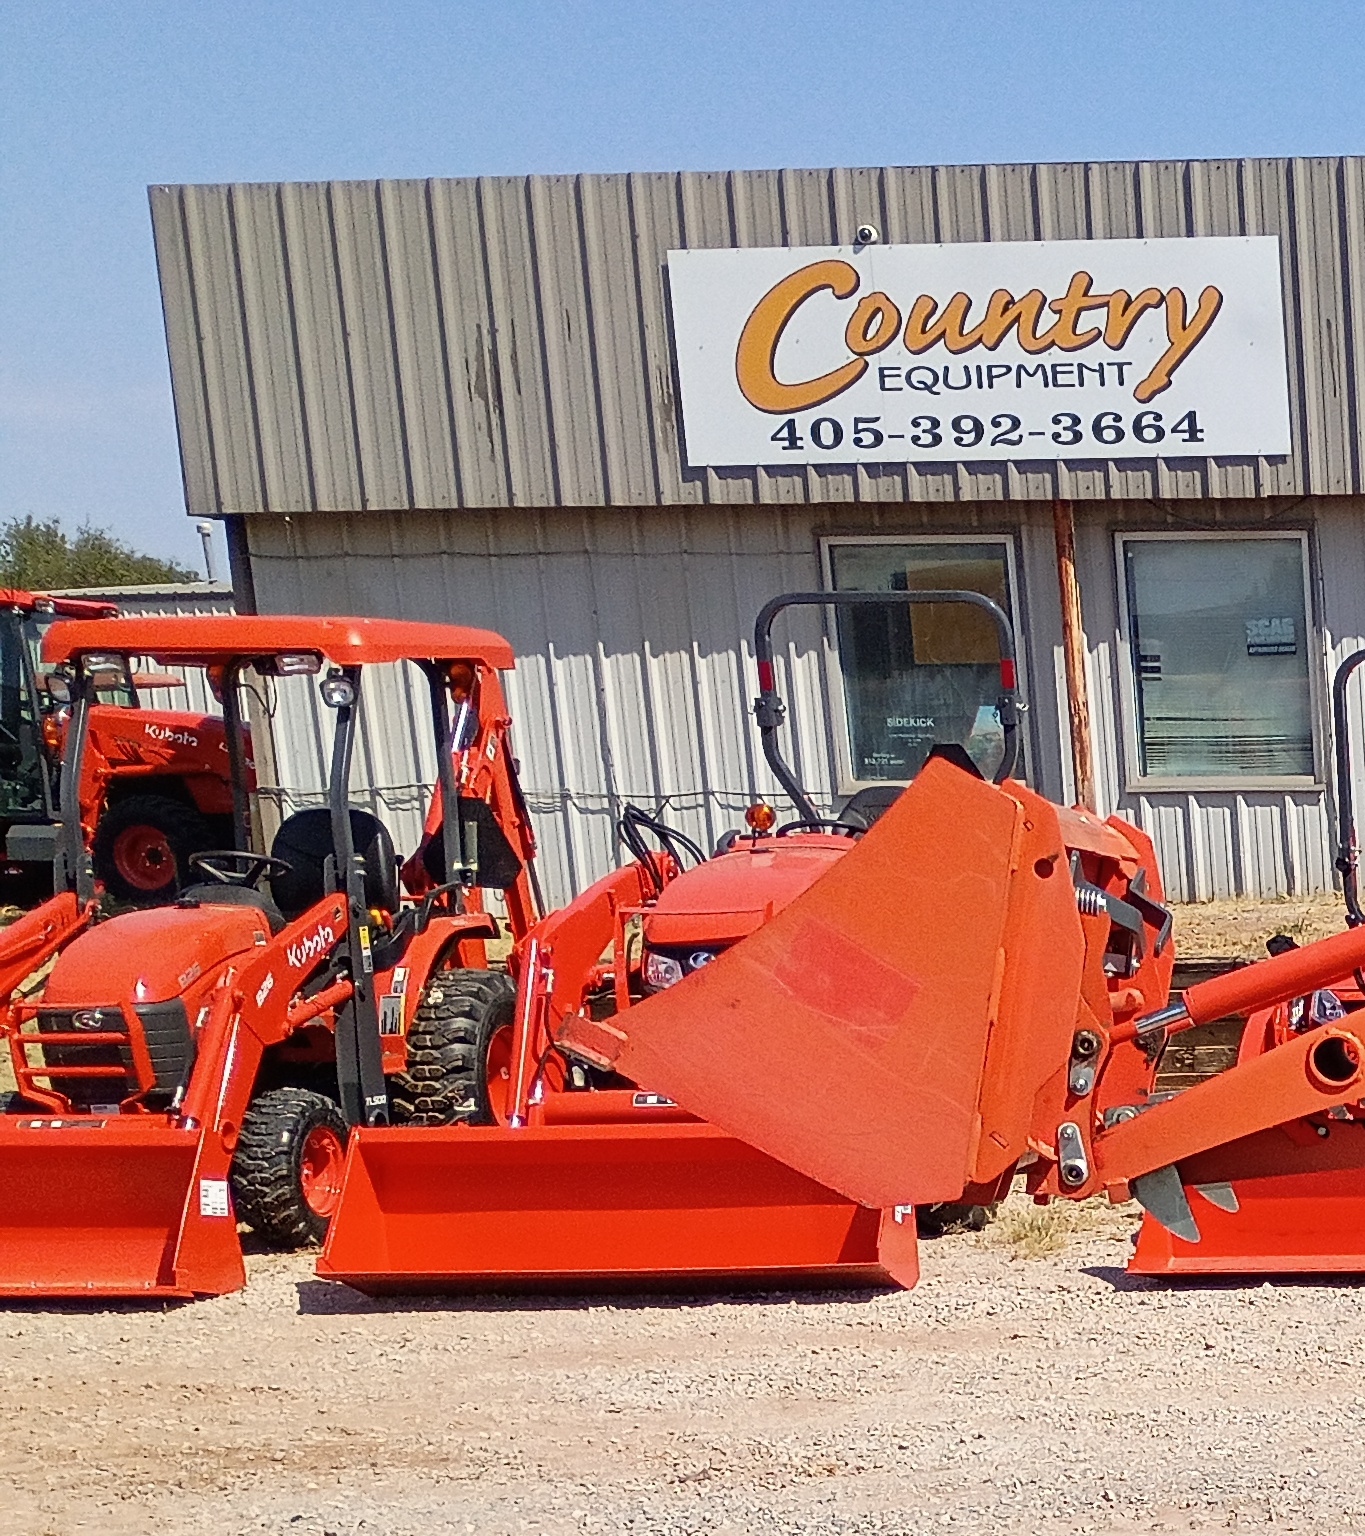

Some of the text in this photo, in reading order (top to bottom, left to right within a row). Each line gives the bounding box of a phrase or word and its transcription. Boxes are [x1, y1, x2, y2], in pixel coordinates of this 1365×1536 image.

[735, 259, 1224, 415] Country
[878, 361, 1133, 396] EQUIPMENT
[770, 410, 1205, 451] 405-392-3664
[144, 723, 198, 747] Kubota
[886, 717, 935, 727] SIDEKICK
[286, 924, 335, 968] Kubota
